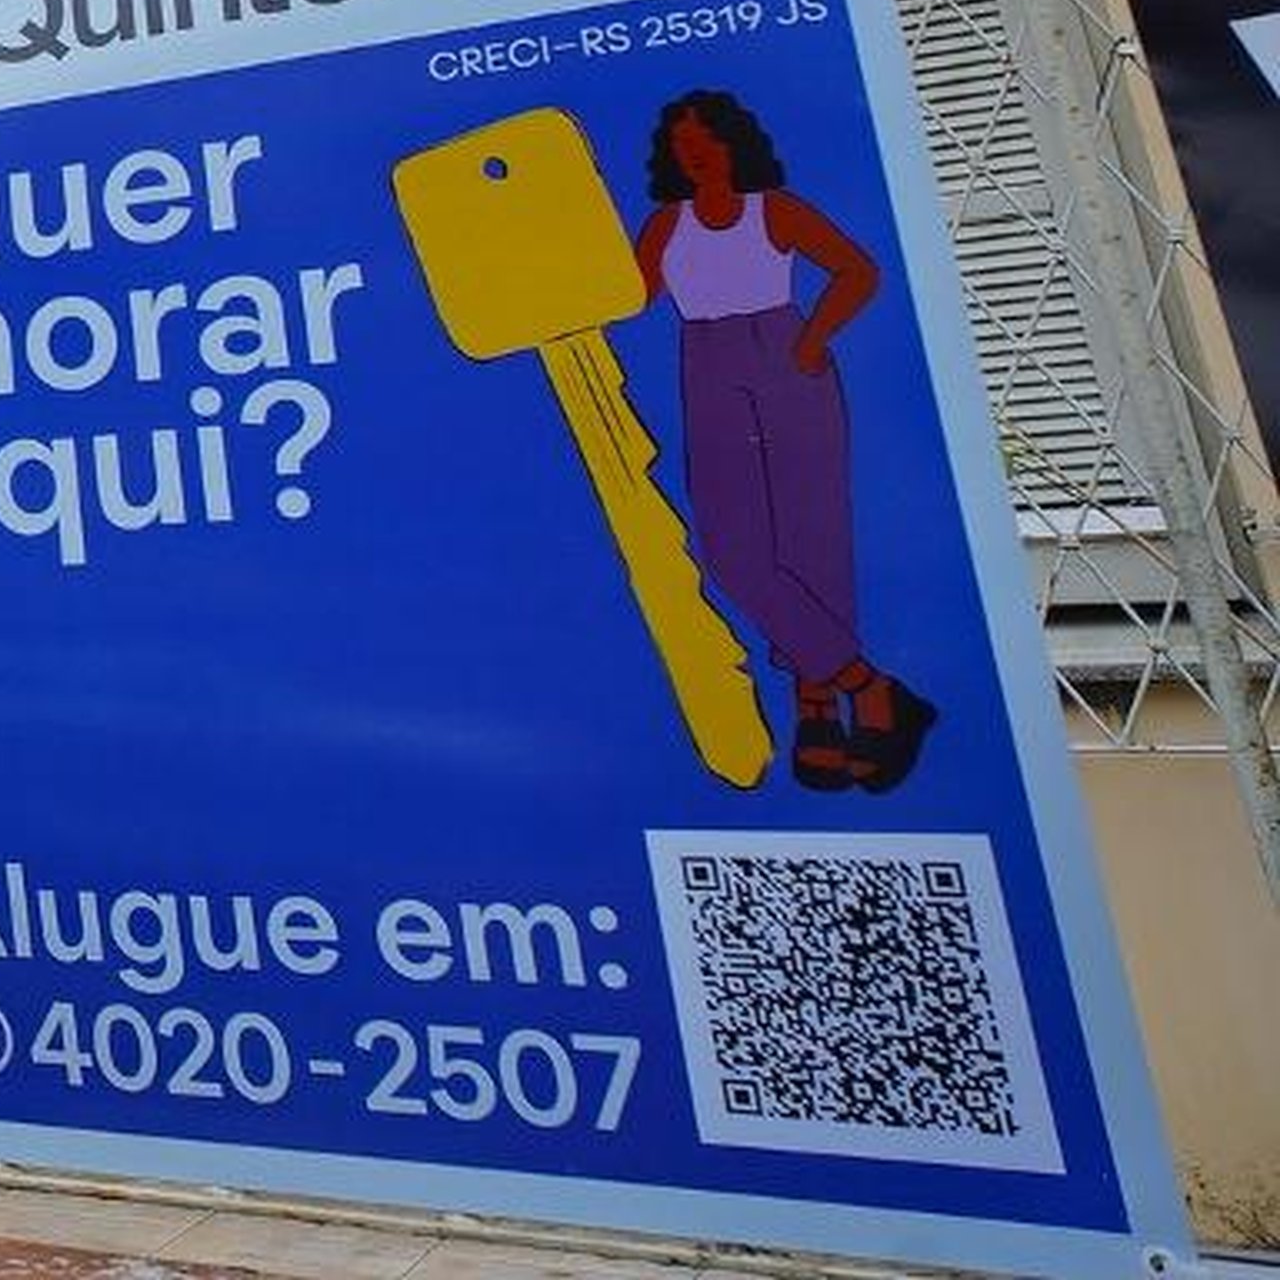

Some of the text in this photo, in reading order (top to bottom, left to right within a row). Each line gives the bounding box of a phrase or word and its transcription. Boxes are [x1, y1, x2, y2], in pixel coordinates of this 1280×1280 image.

[428, 23, 633, 82] CRECI-RS
[644, 0, 763, 48] 25319
[376, 896, 629, 990] em:
